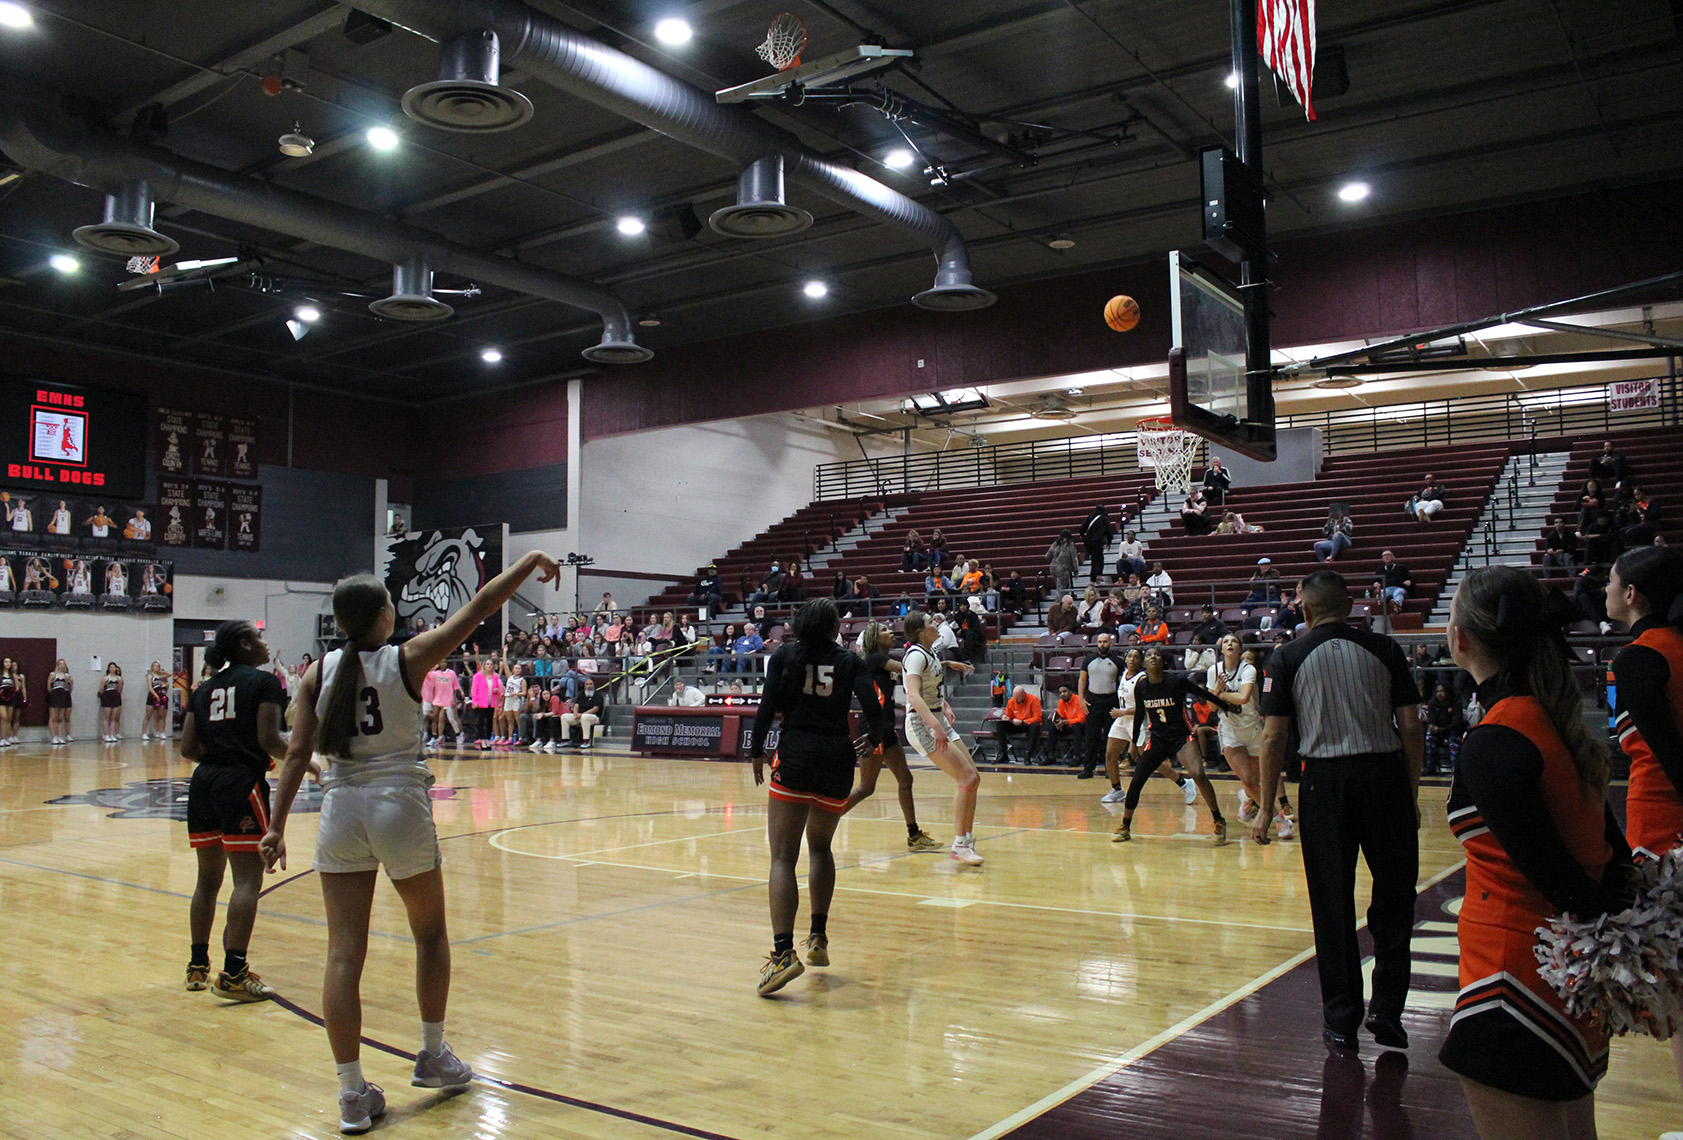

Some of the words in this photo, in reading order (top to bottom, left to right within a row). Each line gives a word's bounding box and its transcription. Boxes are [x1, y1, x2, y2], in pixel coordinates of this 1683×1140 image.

[1615, 381, 1651, 395] VISITOR
[36, 390, 84, 407] EMHS
[1611, 395, 1657, 409] STUDENTS
[8, 464, 54, 481] BULL
[60, 469, 105, 486] DOGS
[167, 489, 184, 499] STATE
[203, 491, 219, 501] STATE
[237, 495, 253, 504] STATE
[161, 497, 190, 507] CHAMPIONS
[197, 498, 224, 509] CHAMPIONS
[232, 502, 258, 512] CHAMPIONS
[803, 664, 835, 697] 15
[209, 686, 236, 722] 21
[1143, 697, 1176, 709] ORIGINAL
[352, 686, 384, 736] 3
[1156, 708, 1167, 723] 3
[636, 722, 673, 736] EDMOND
[673, 723, 722, 738] MEMORIAL
[645, 735, 669, 746] HIGH
[671, 736, 710, 747] SCHOOL
